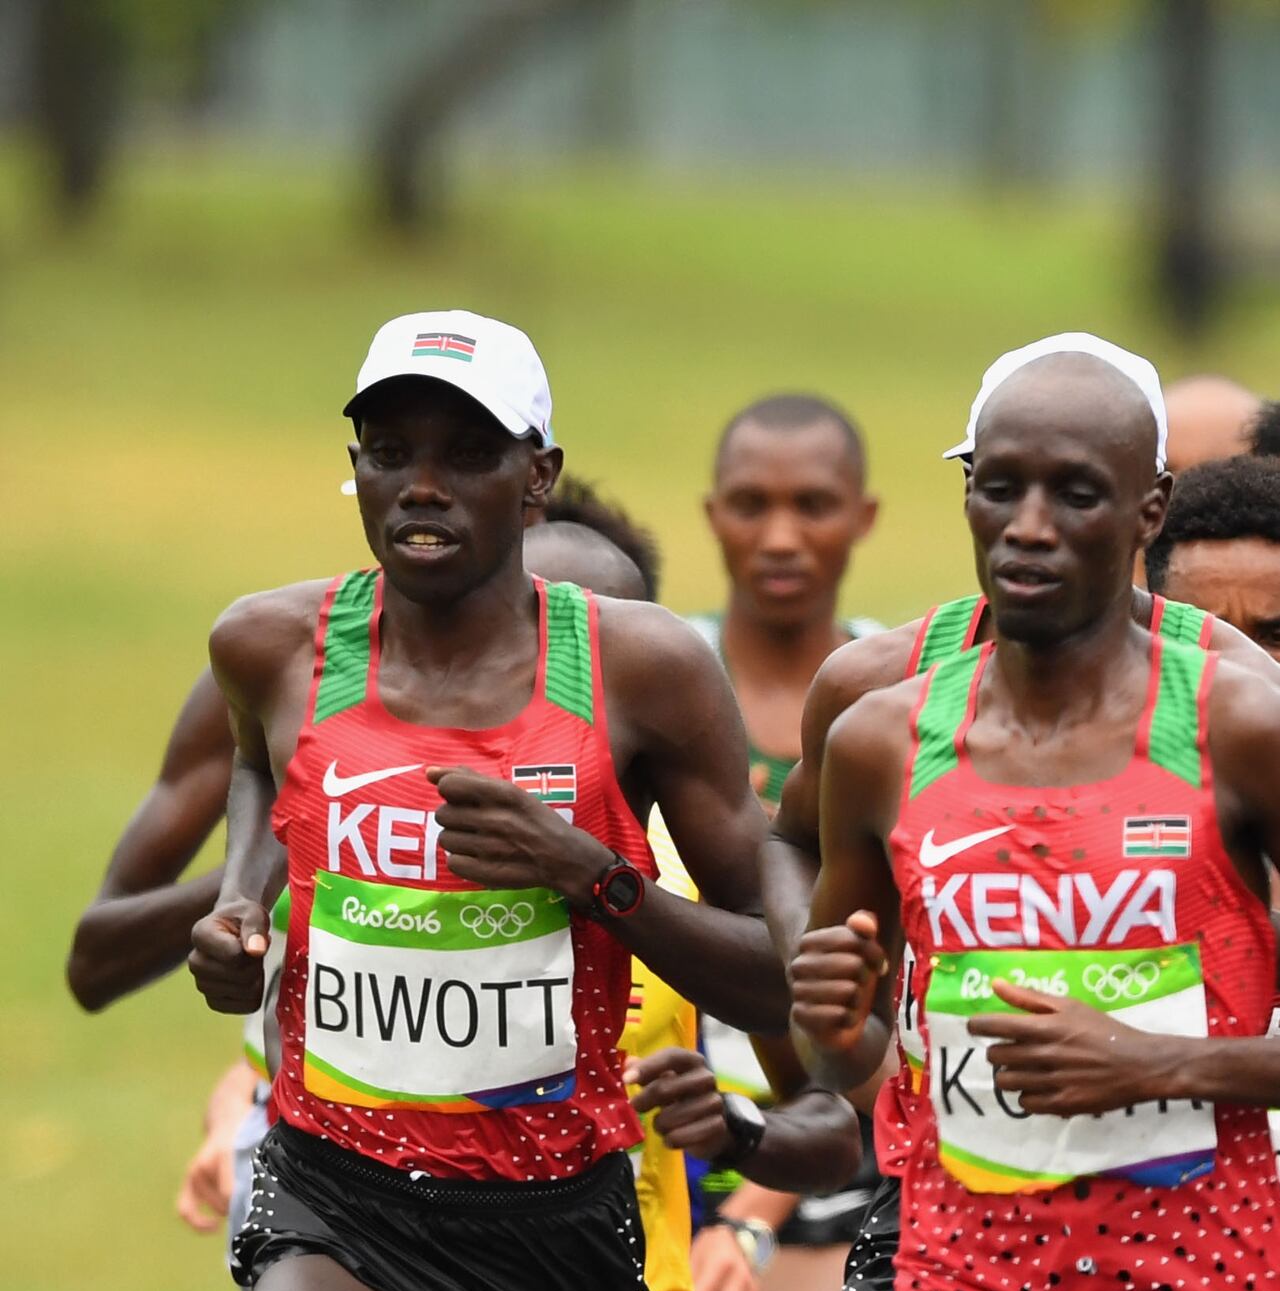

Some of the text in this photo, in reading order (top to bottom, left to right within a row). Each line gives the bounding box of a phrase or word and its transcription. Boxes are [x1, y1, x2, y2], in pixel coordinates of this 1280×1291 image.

[341, 896, 441, 934] Rio2016
[921, 869, 1176, 947] KENYA
[313, 962, 569, 1048] BIWOTT
